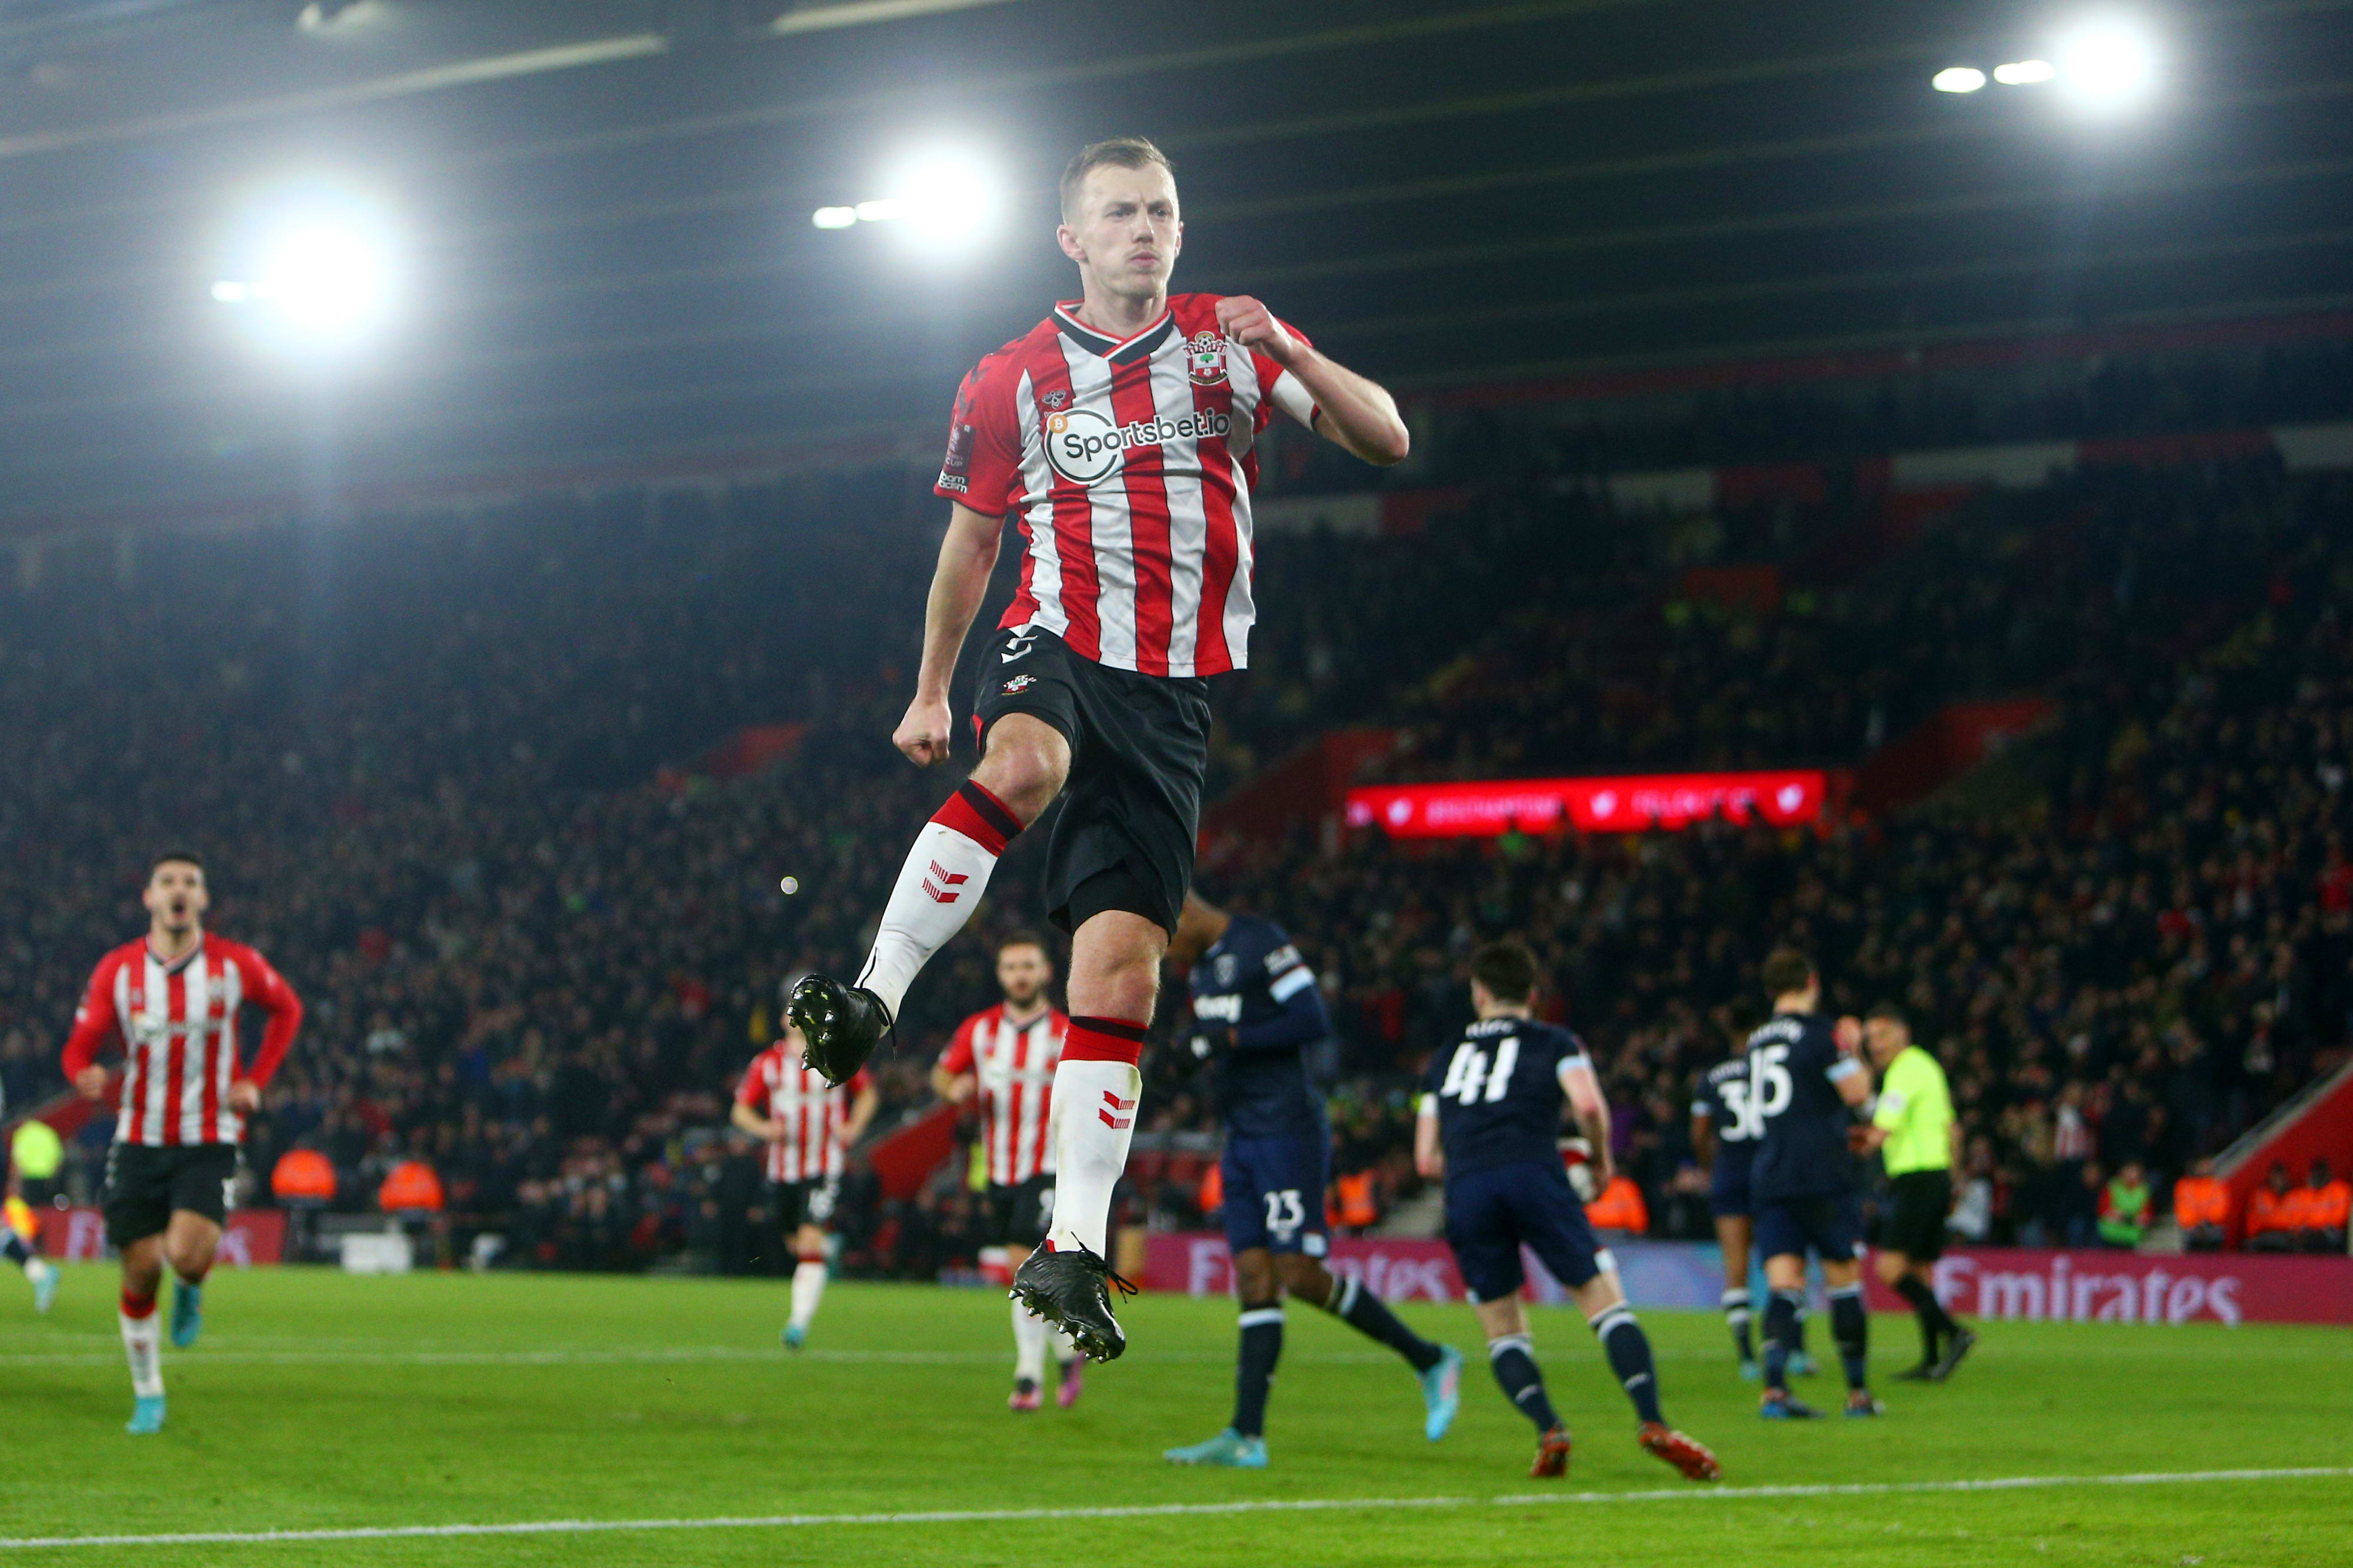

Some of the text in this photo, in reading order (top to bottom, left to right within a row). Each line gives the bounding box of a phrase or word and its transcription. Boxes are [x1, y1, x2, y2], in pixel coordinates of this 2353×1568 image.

[1064, 408, 1229, 462] Sportsbet.io
[1439, 1036, 1521, 1105] 41
[1749, 1043, 1793, 1116] 15
[1263, 1190, 1305, 1232] 23
[1931, 1255, 2243, 1328] Emirates
